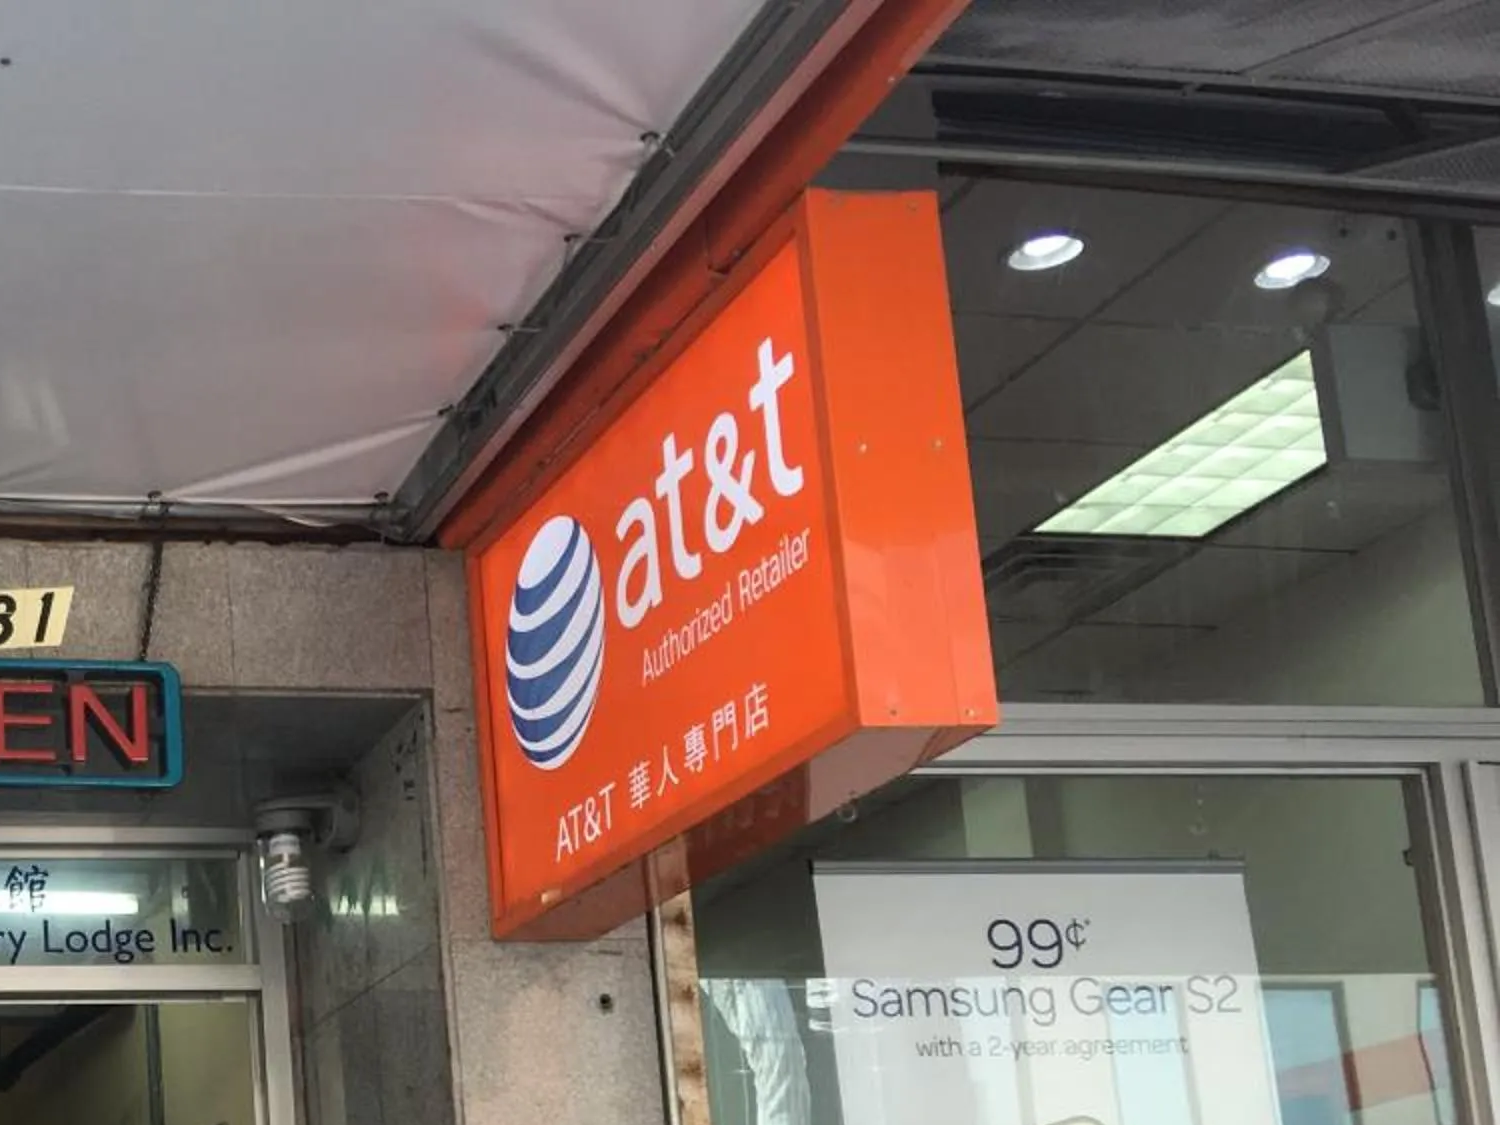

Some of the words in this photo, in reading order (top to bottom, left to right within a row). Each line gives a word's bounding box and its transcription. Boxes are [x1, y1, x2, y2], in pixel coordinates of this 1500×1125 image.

[615, 337, 803, 629] at&t
[642, 583, 732, 687] Authorized
[738, 528, 811, 612] Retailer
[556, 781, 616, 862] AT&T
[628, 682, 769, 809] 華人專門店
[42, 919, 155, 963] Lodge
[170, 920, 234, 955] Inc.
[851, 978, 1057, 1027] Samsung
[1069, 977, 1174, 1016] Gear
[1187, 975, 1242, 1014] S2
[915, 1037, 963, 1058] with
[968, 1042, 982, 1057] a
[988, 1037, 1056, 1062] 2-year
[1064, 1036, 1190, 1061] agreement
